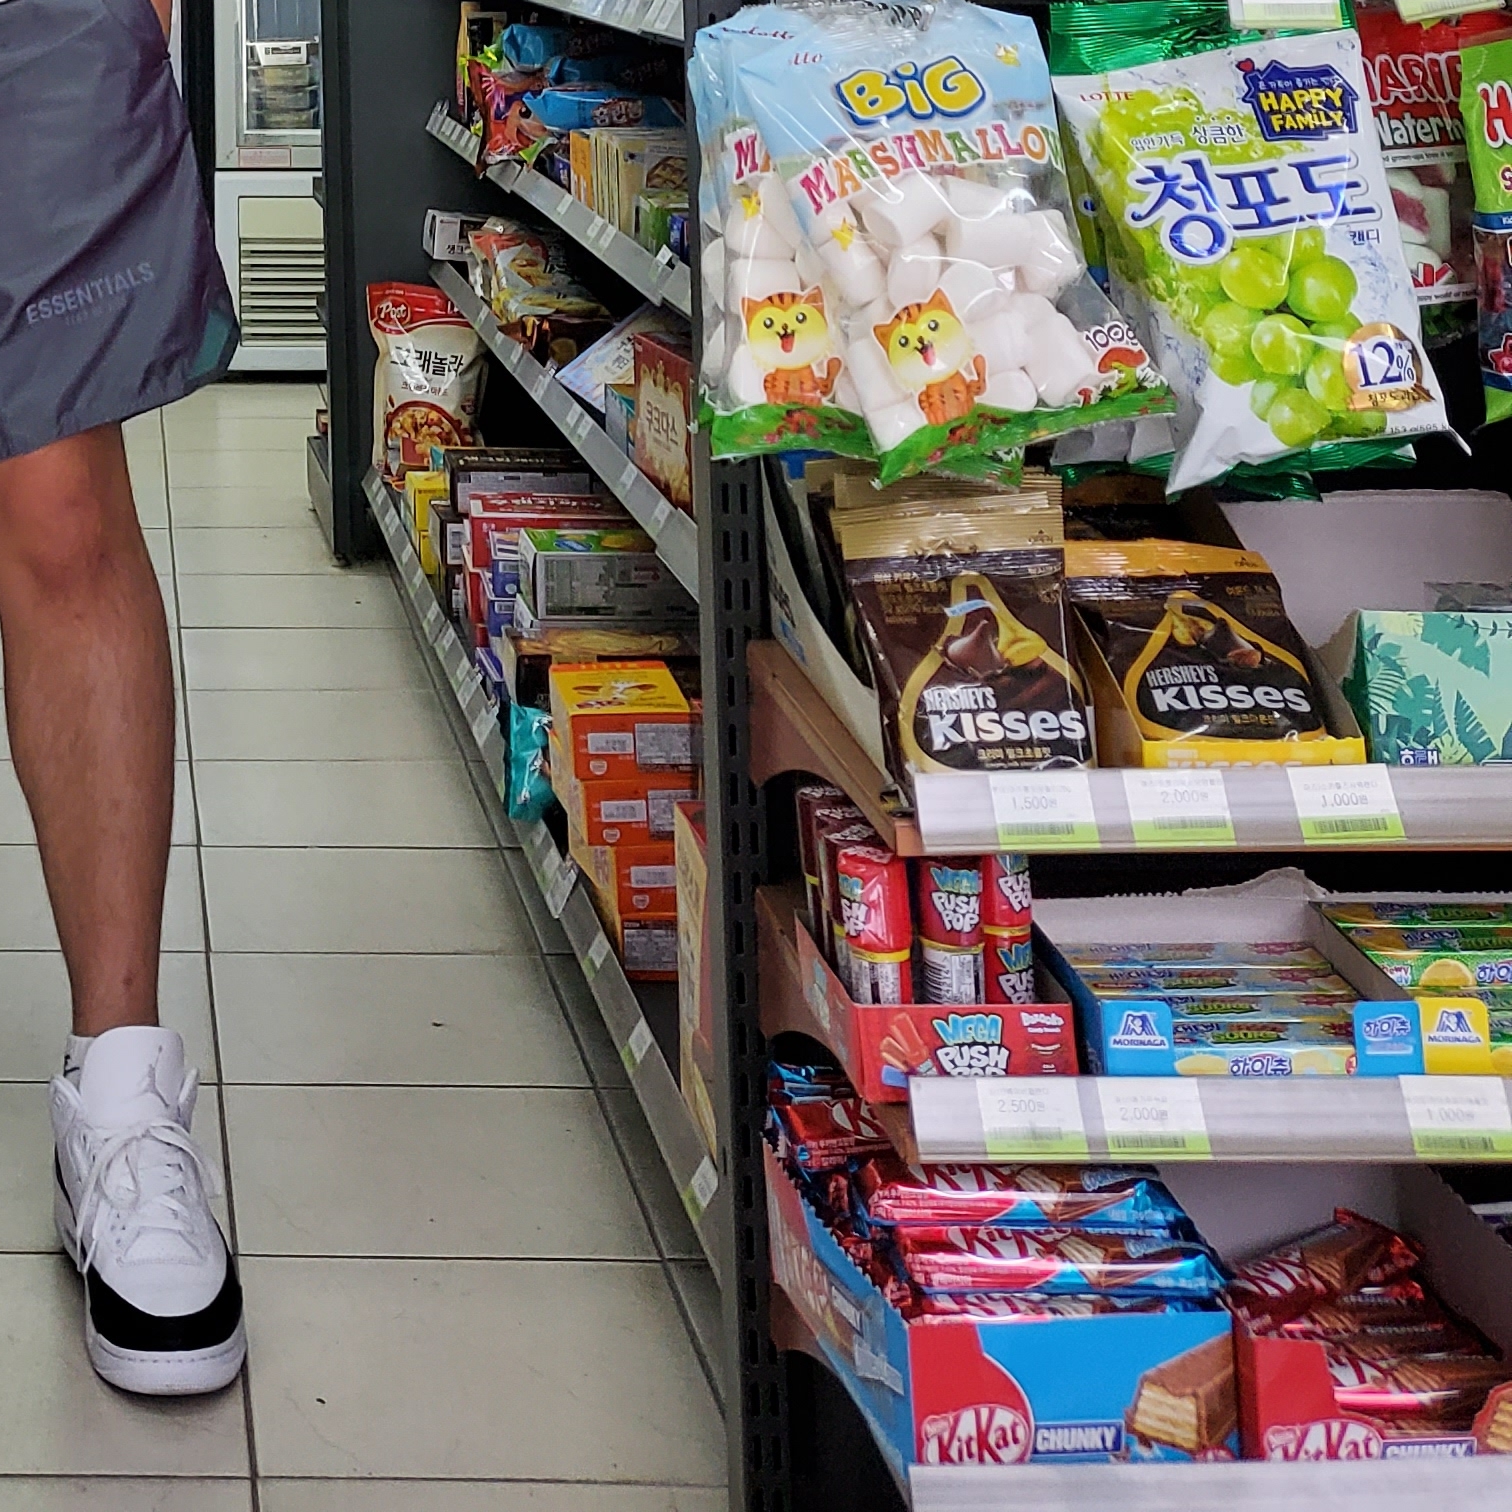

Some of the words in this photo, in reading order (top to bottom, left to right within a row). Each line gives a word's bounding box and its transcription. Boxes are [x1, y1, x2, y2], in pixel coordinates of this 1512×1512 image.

[1080, 90, 1135, 103] LOTTE
[1258, 87, 1345, 114] HAPPY
[1191, 122, 1245, 145] 상큼한
[1130, 155, 1382, 259] 청포도
[1349, 228, 1381, 245] 캔디
[25, 260, 155, 325] ESSENTIALS
[379, 301, 407, 319] Post
[1349, 341, 1415, 388] 12%
[1146, 665, 1219, 686] HERSHEY'S
[924, 685, 997, 714] HERSHEY'S
[1011, 795, 1058, 810] 1,500원
[1321, 791, 1369, 808] 1,000원
[931, 891, 981, 915] PUSH
[943, 911, 980, 933] POP
[932, 1013, 1003, 1045] MEGA
[937, 1044, 1010, 1070] PUSH
[1230, 1054, 1292, 1076] 하이츄
[997, 1098, 1046, 1114] 2,500원
[1119, 1106, 1169, 1122] 2,000원
[934, 1408, 1027, 1465] KitKat
[1036, 1424, 1118, 1453] CHUNKY
